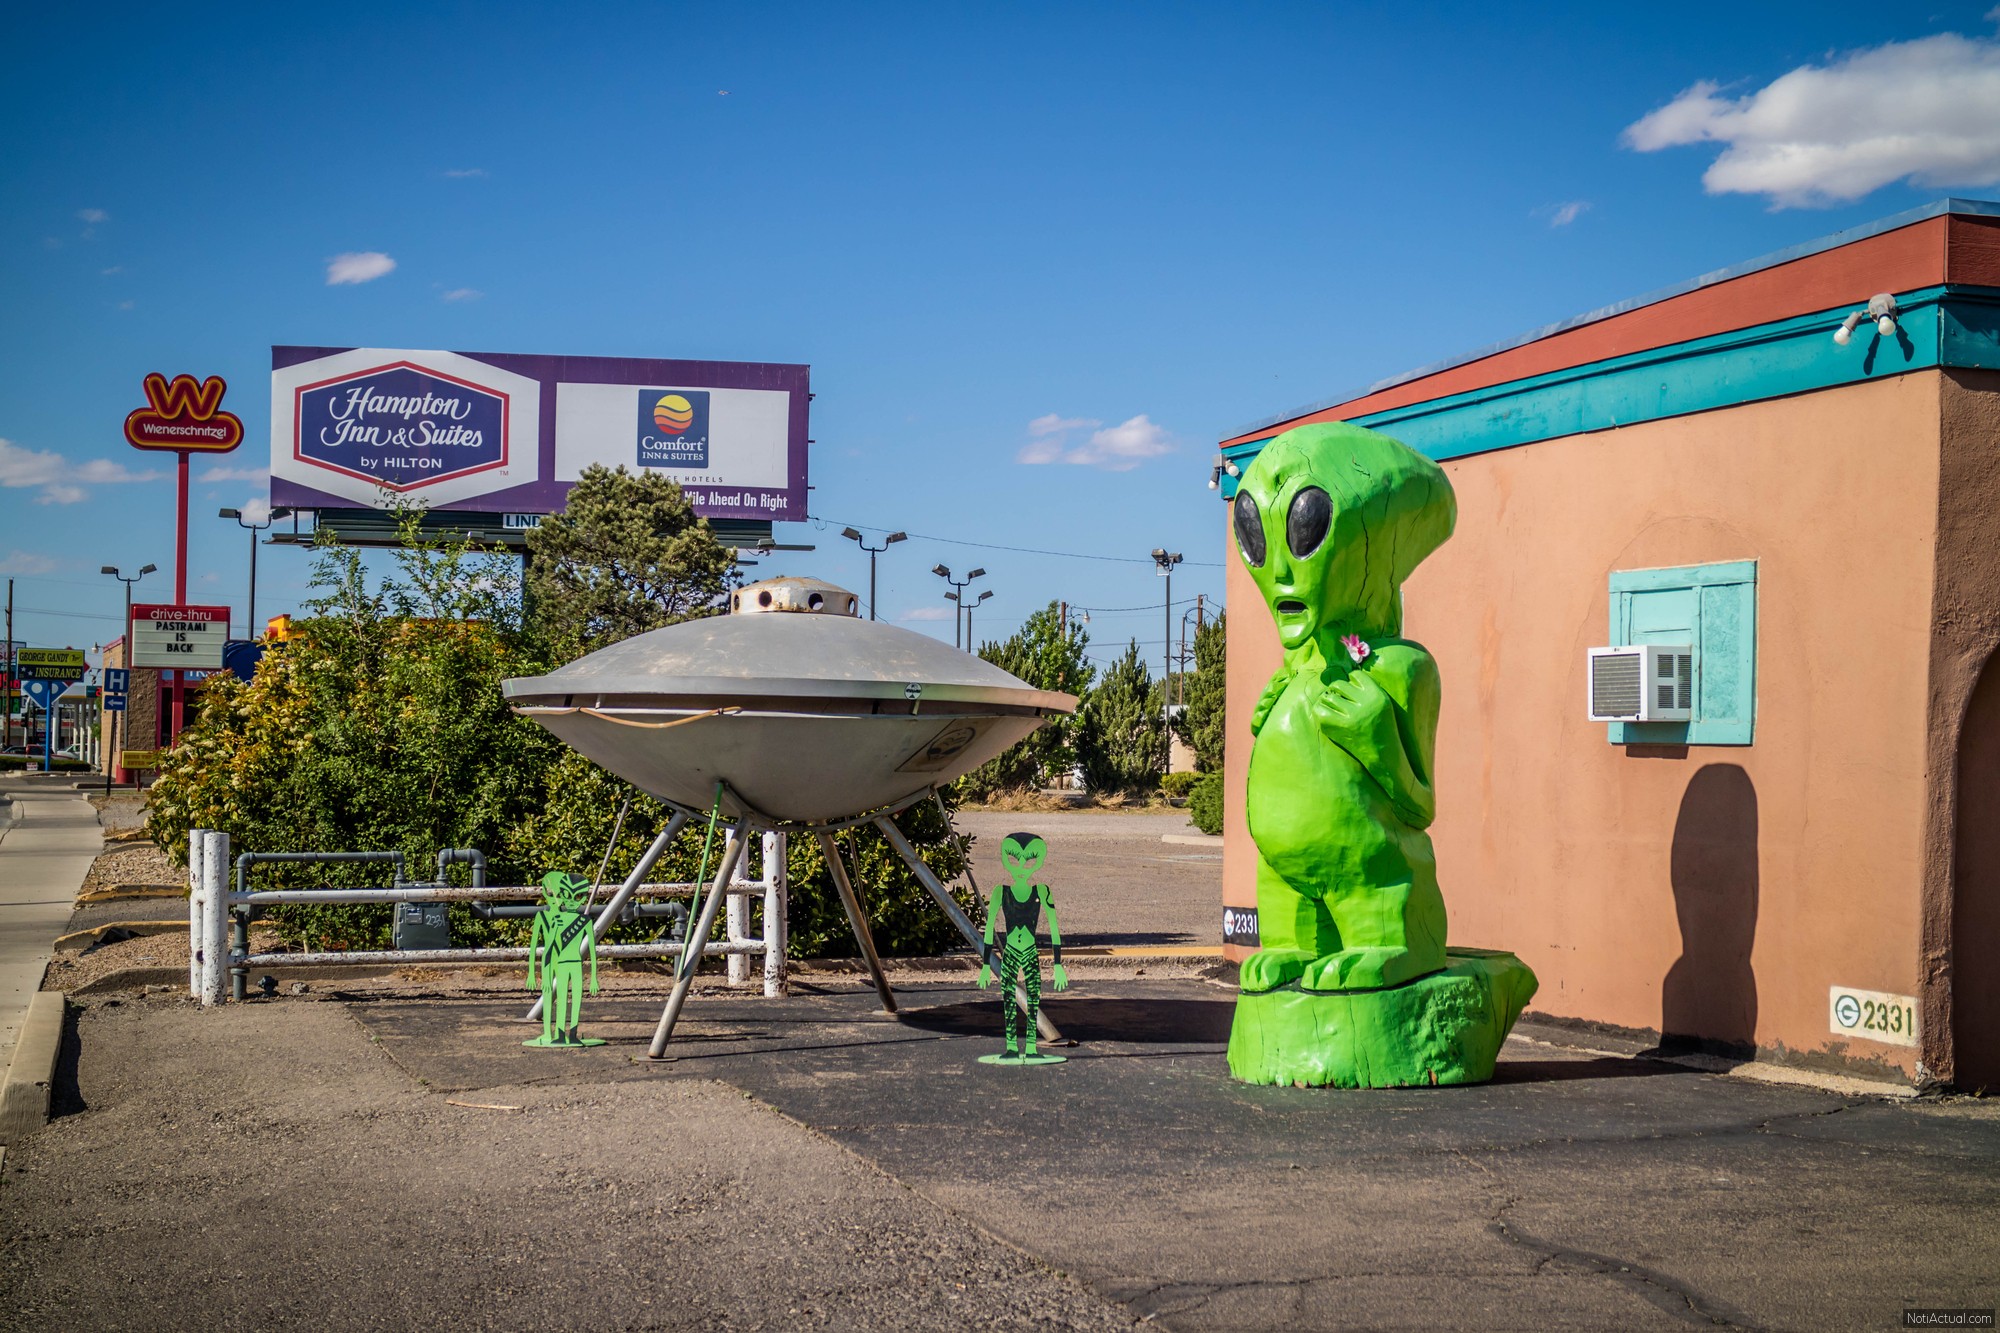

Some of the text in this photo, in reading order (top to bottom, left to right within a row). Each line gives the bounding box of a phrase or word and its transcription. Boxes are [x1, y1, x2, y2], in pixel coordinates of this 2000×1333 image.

[329, 386, 471, 420] Hampton
[143, 423, 227, 440] Wienerschnitzel
[320, 418, 483, 448] Inn & Suites
[642, 436, 704, 451] Comfort
[360, 456, 442, 469] by HILTON
[642, 452, 661, 460] INN
[671, 453, 704, 461] SUITES
[684, 475, 723, 483] HOTELS
[708, 491, 741, 507] Ahead
[743, 492, 757, 508] On
[760, 493, 788, 512] Right
[506, 514, 542, 528] LIND
[151, 608, 212, 620] drive-thru
[156, 621, 207, 631] PASTRAMI
[176, 632, 186, 642] IS
[166, 643, 193, 653] BACK
[20, 652, 45, 662] GEORGE
[35, 667, 82, 679] INSURANCE
[109, 671, 125, 690] H
[1235, 913, 1258, 934] 2331
[1863, 1000, 1913, 1036] 2331
